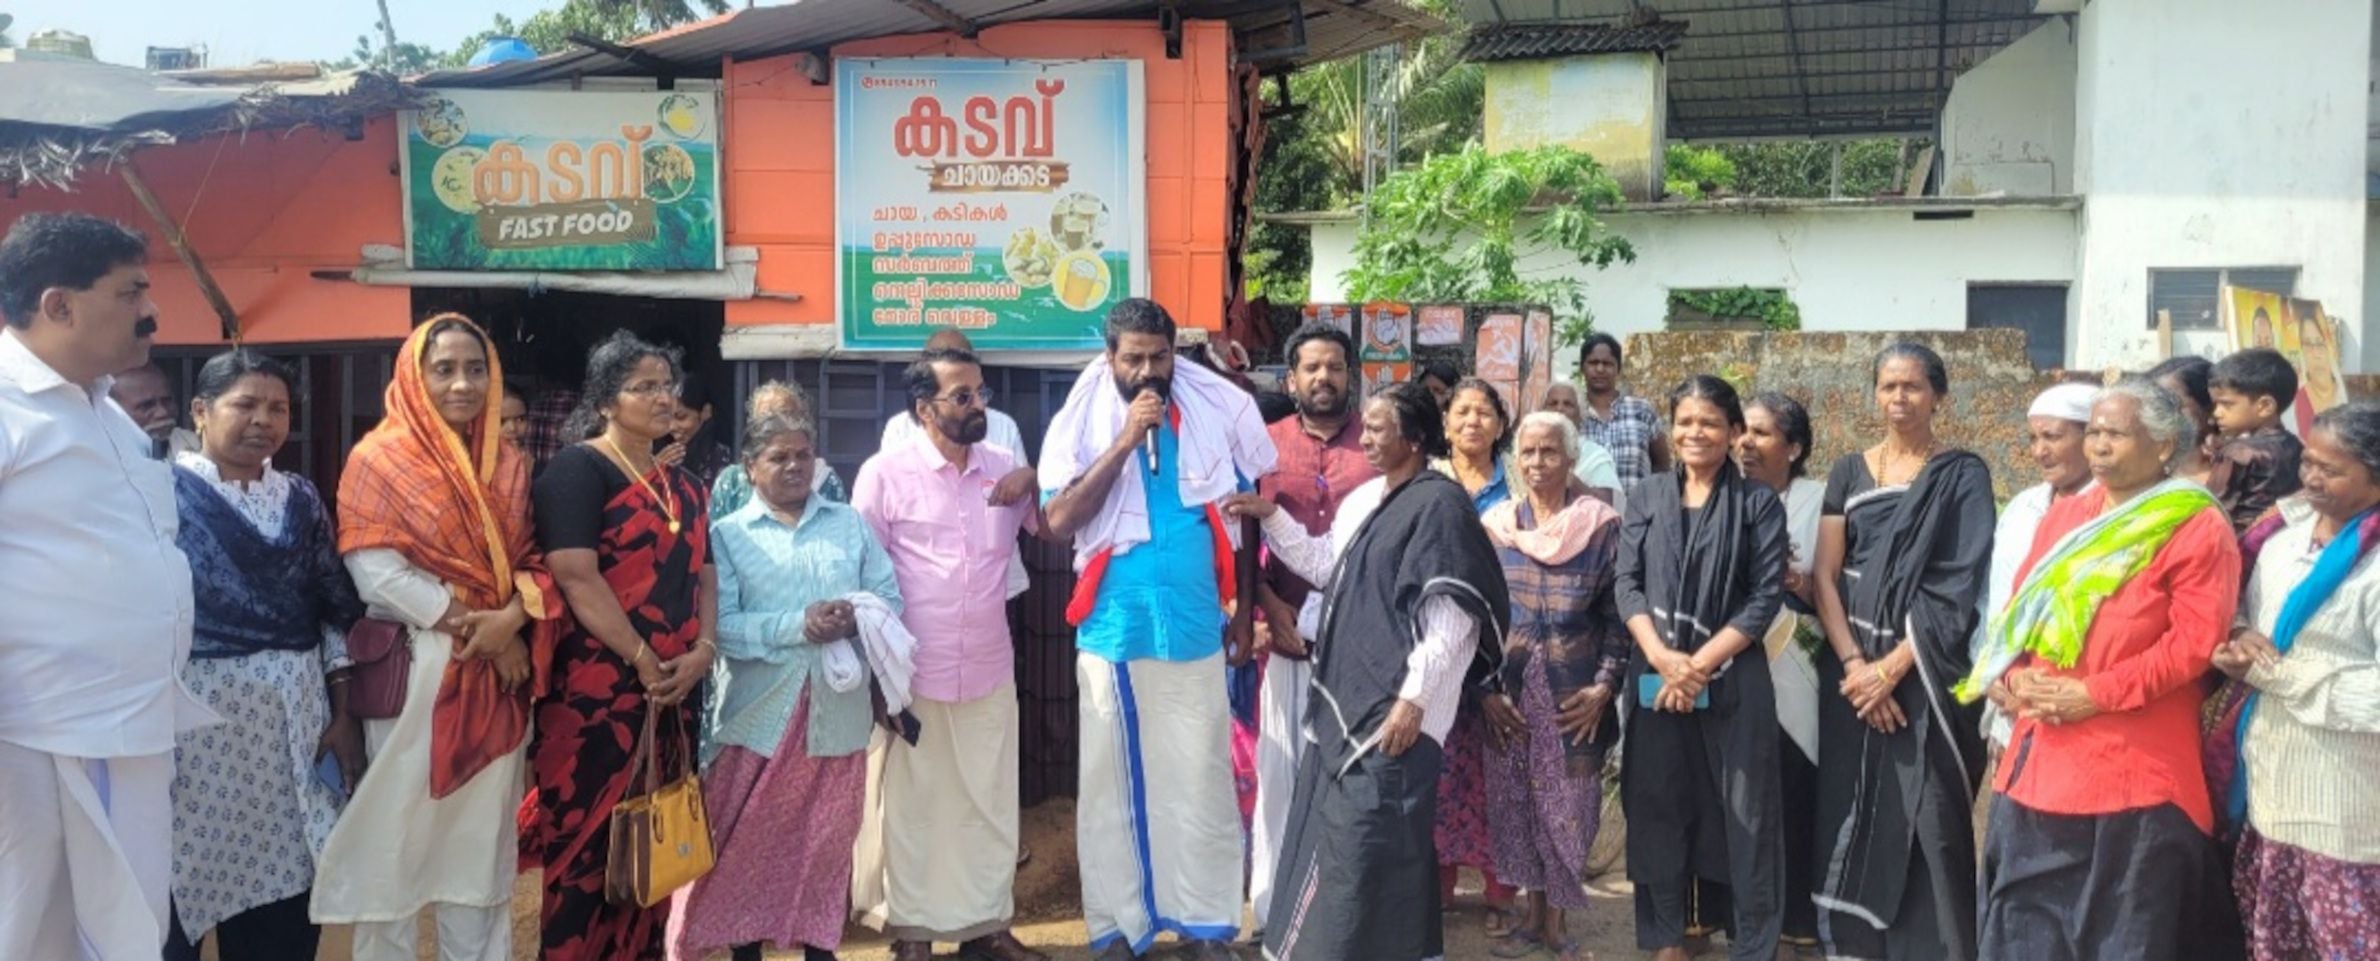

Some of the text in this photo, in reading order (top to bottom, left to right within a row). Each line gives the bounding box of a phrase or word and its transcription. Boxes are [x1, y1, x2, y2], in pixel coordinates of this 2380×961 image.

[895, 79, 1064, 157] കടവ്
[943, 163, 1049, 187] ചായക്കട
[499, 210, 633, 240] FAST FOOD
[873, 206, 917, 221] ചായ
[932, 202, 1007, 221] കടികൾ
